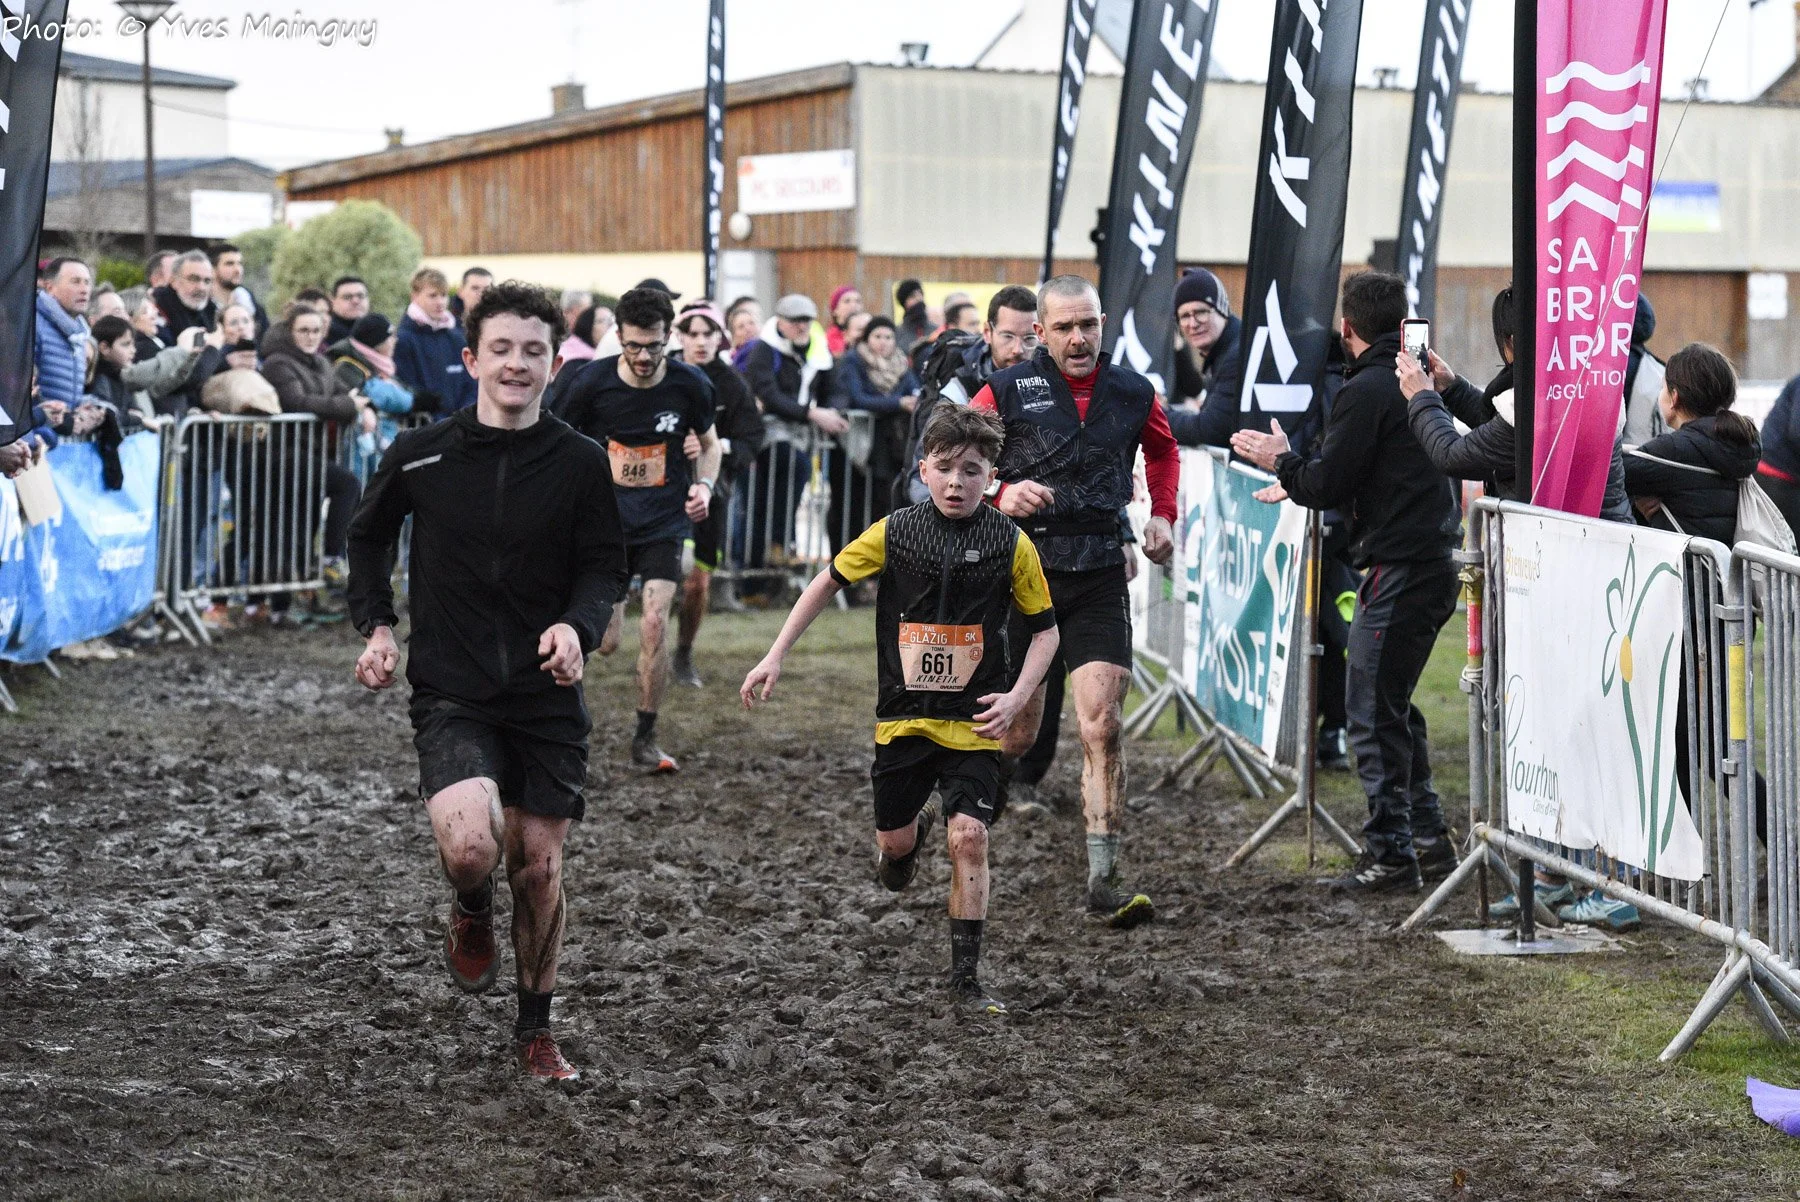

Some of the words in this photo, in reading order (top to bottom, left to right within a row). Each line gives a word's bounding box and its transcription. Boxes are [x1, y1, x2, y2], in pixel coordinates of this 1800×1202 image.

[622, 463, 647, 477] 848
[921, 625, 936, 633] TRAIL
[910, 631, 948, 645] GLAZIG
[965, 632, 976, 642] 5K
[921, 652, 954, 675] 661
[915, 674, 960, 684] KINETIK
